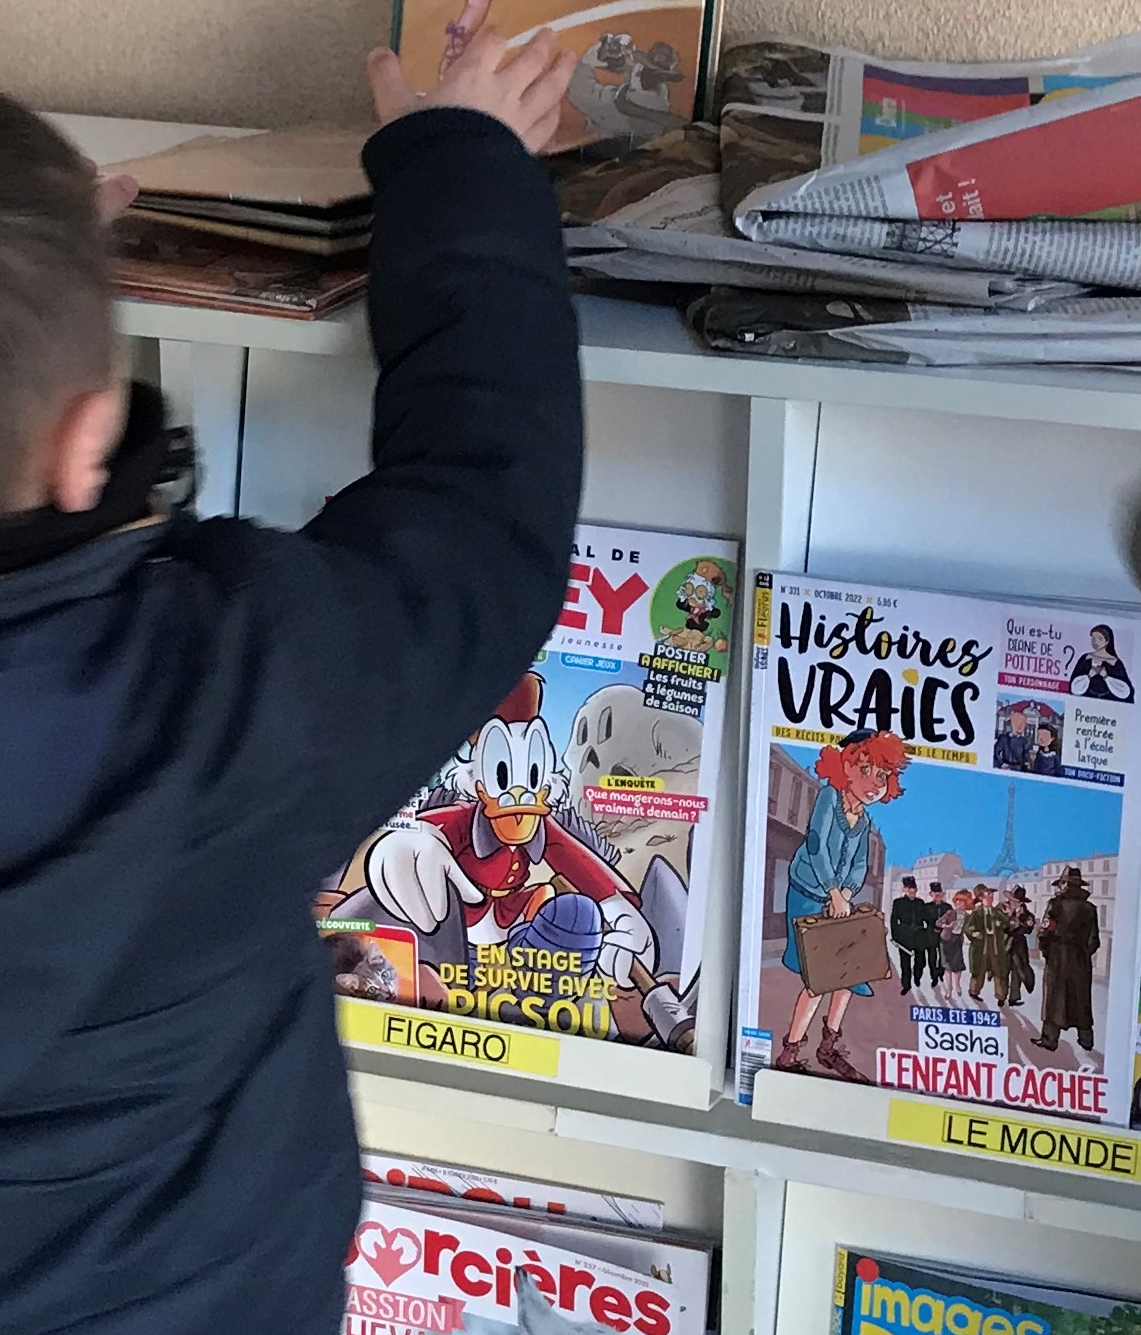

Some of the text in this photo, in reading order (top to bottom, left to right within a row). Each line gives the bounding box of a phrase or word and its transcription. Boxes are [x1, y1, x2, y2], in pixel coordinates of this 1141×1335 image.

[936, 191, 956, 214] et
[611, 548, 641, 564] DE
[814, 589, 843, 602] OCTOBRE
[845, 592, 862, 604] 2022
[775, 601, 993, 677] Histoires
[1006, 618, 1062, 641] Qui es-tu
[560, 636, 623, 651] jeunesse
[1008, 638, 1053, 657] DIANE DE
[595, 658, 617, 670] JEUX
[657, 644, 707, 665] POSTER
[1005, 645, 1076, 677] POITIERS ?
[649, 670, 704, 690] Les fruits
[1018, 677, 1060, 690] PERSONNAGE
[645, 682, 704, 704] & légumes
[645, 696, 700, 716] de saison
[1075, 708, 1117, 727] Première
[774, 726, 791, 738] DES
[1076, 724, 1114, 740] rentrée
[926, 746, 938, 758] LE
[940, 748, 970, 763] TEMPS
[1083, 737, 1114, 754] l'école
[585, 788, 706, 809] Que mangerons-nous
[593, 802, 645, 816] vraiment
[646, 806, 689, 820] demain
[478, 944, 582, 972] EN STAGE
[440, 962, 618, 1000] DE SURVIE AVEC
[446, 988, 611, 1039] PICSOU
[972, 1010, 998, 1026] 1942
[387, 1016, 506, 1062] FIGARO
[924, 1024, 1004, 1058] Sasha,
[879, 1050, 1109, 1114] L'ENFANT CACHÉE
[946, 1115, 1134, 1174] LE MONDE
[345, 1286, 446, 1331] ASSION
